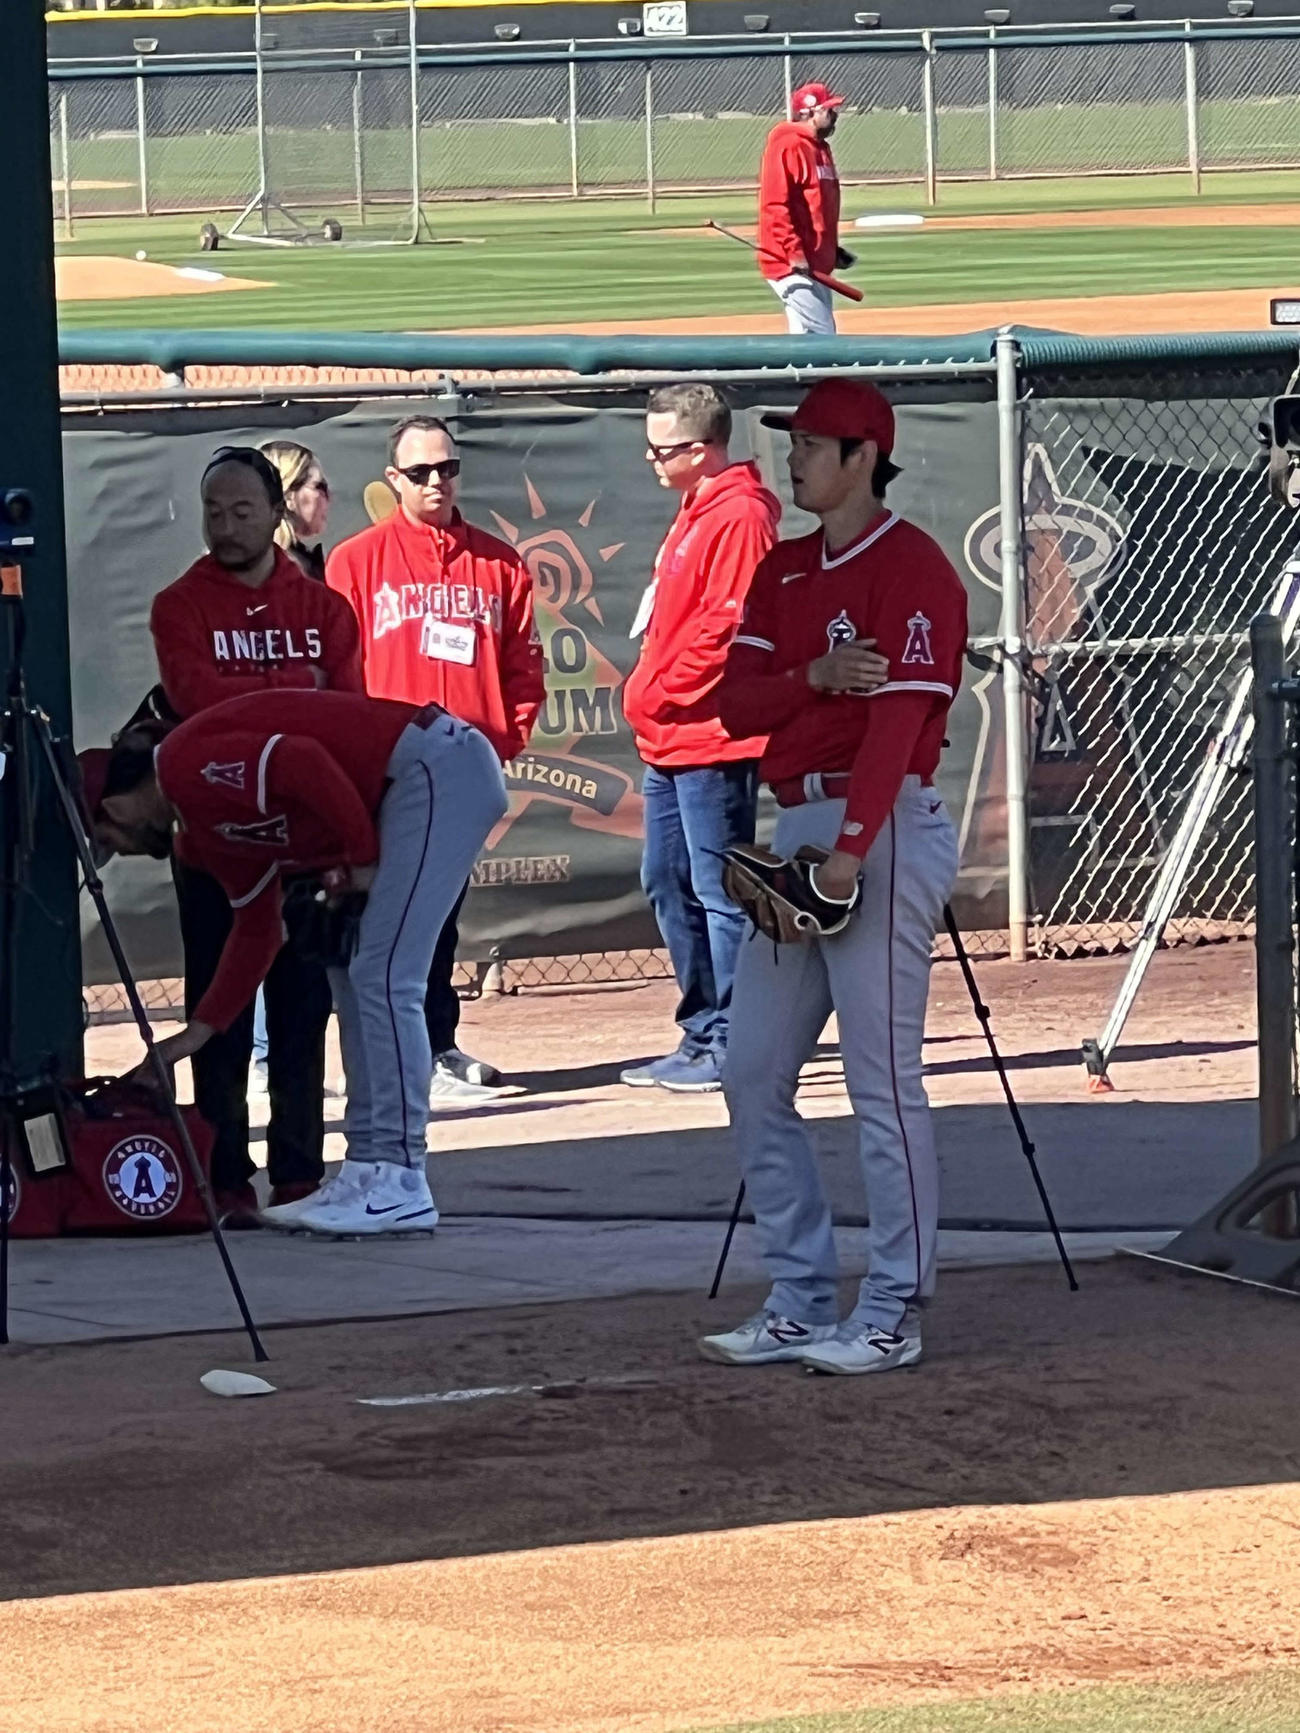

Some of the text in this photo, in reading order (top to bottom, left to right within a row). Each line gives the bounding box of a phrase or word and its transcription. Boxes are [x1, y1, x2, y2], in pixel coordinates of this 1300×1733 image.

[646, 6, 683, 32] 422
[213, 628, 321, 660] ANGELS
[902, 610, 934, 664] A
[503, 757, 598, 799] Arizona
[132, 1156, 157, 1199] A
